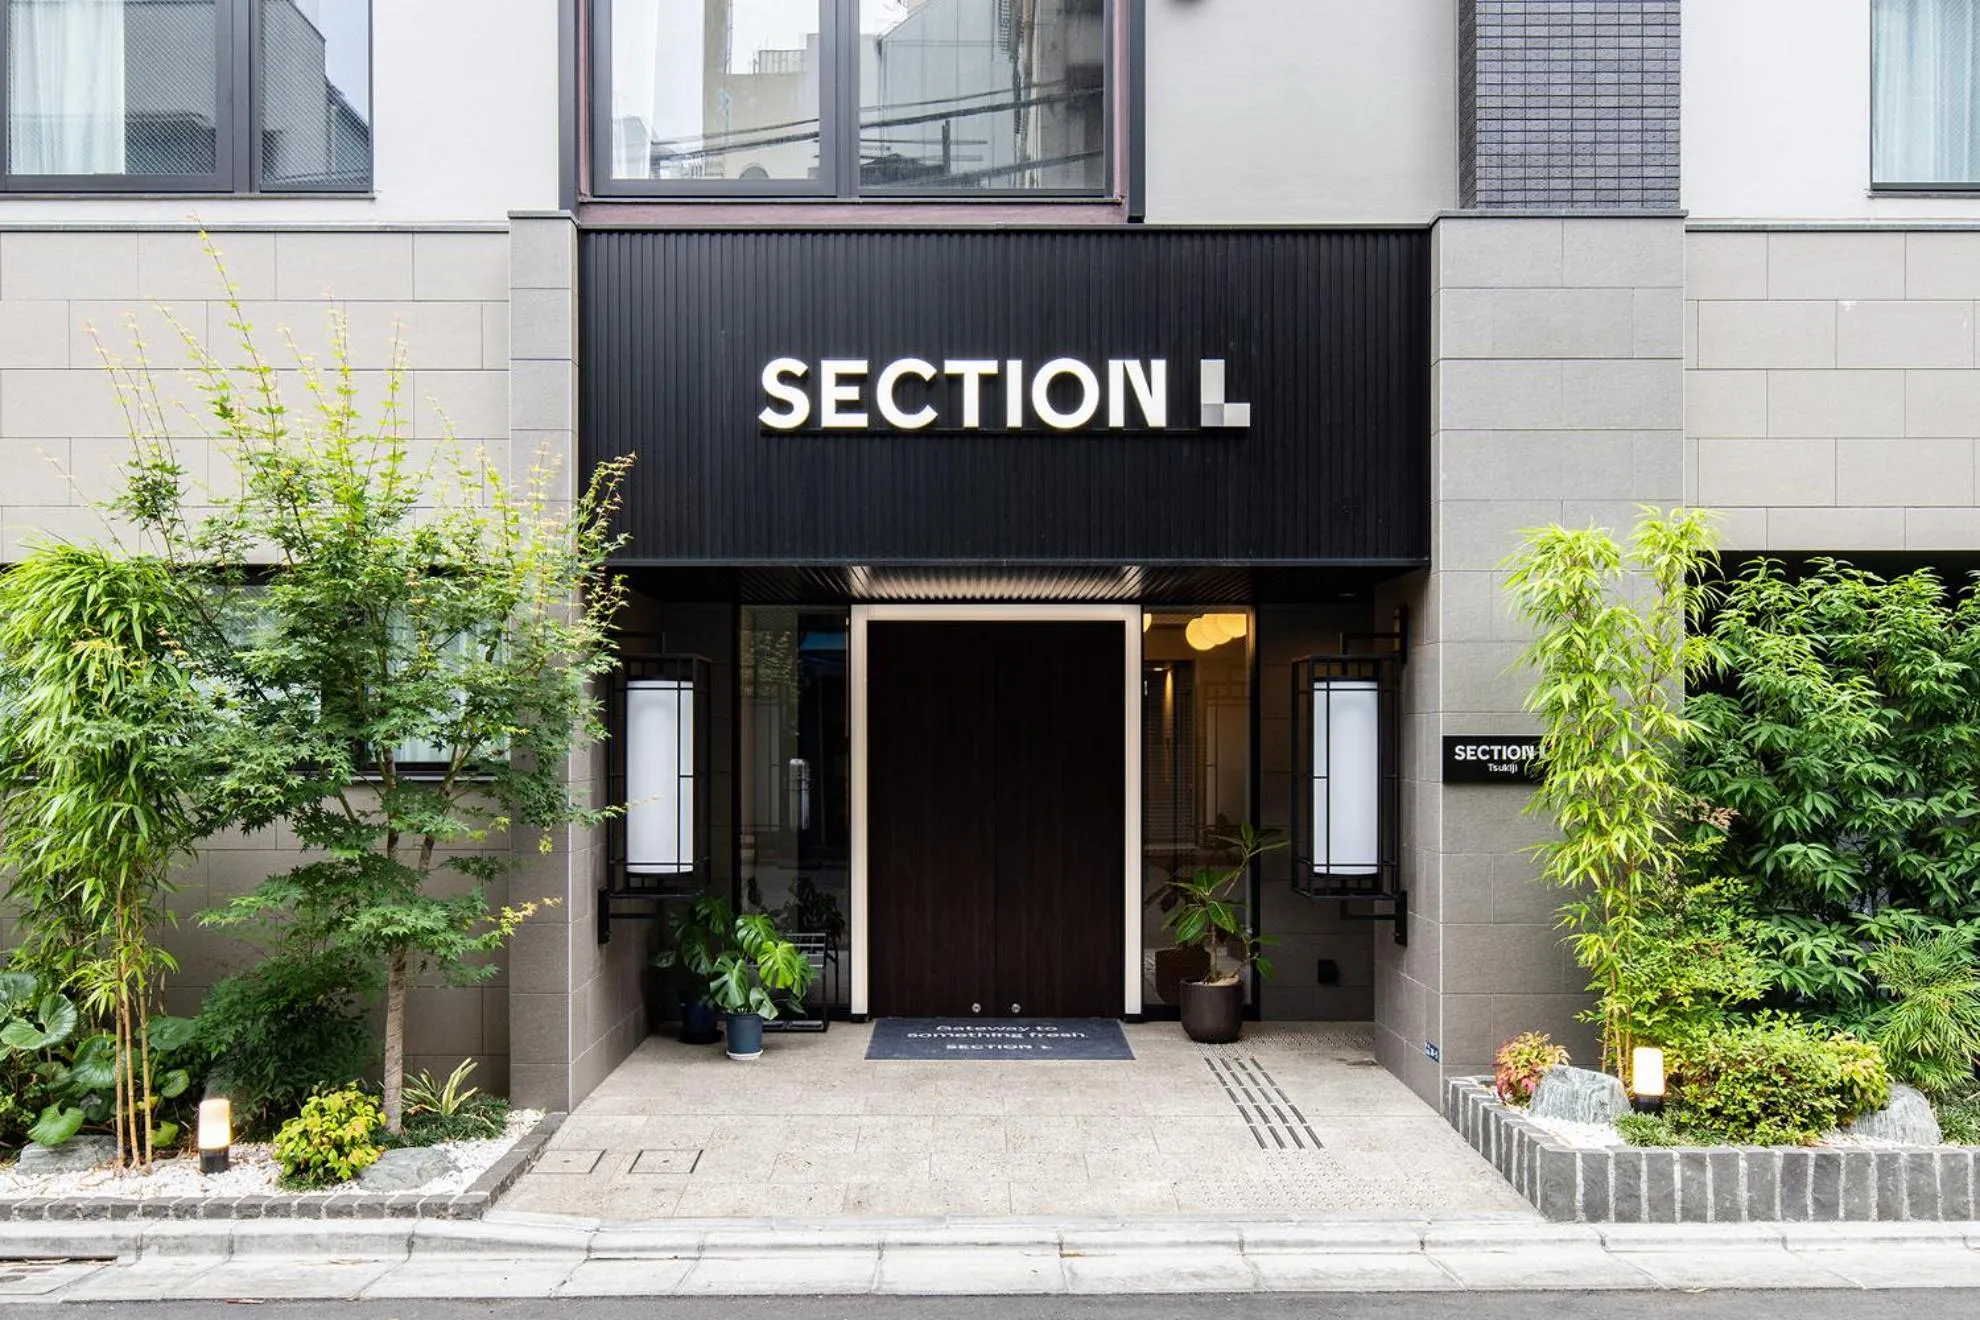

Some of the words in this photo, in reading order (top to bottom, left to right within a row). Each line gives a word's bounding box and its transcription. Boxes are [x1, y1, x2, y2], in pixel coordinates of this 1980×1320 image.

[758, 357, 1167, 429] SECTION
[1200, 359, 1250, 427] L
[1454, 745, 1534, 760] SECTION
[1487, 763, 1518, 774] Tsukiji
